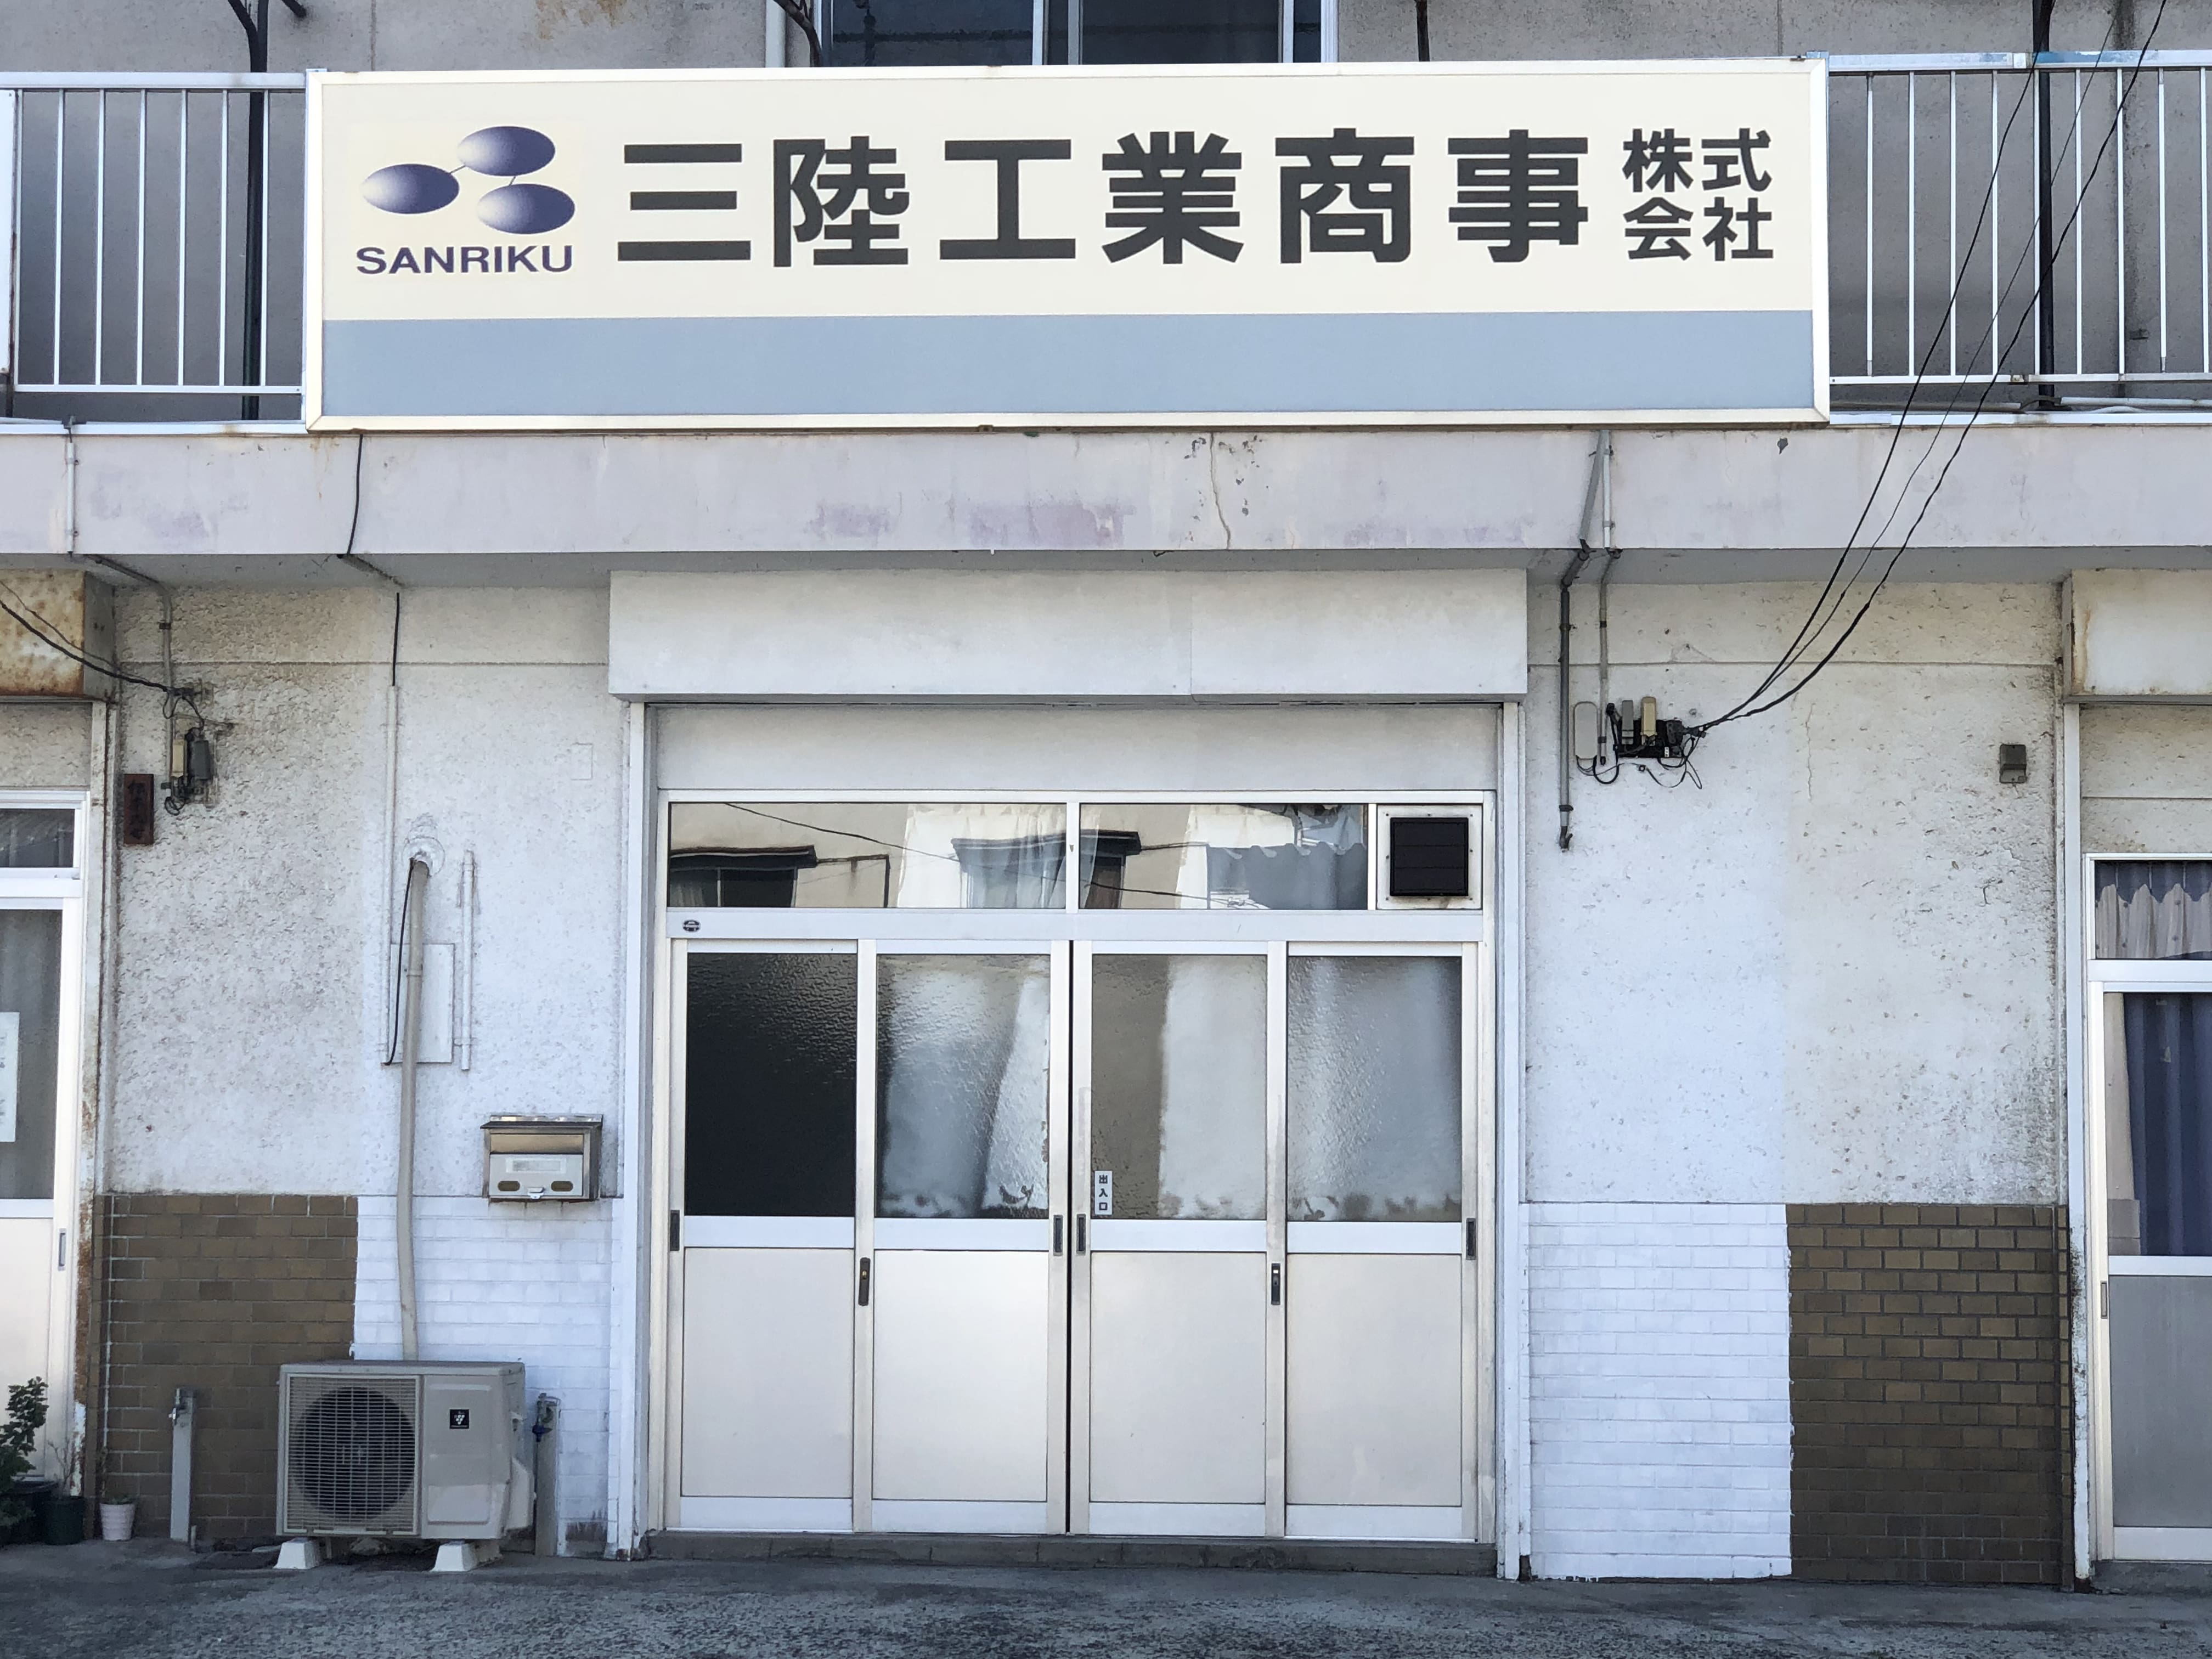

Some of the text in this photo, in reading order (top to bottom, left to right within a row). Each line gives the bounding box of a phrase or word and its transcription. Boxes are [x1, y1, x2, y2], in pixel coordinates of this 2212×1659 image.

[618, 128, 1588, 267] 三陸工業商事
[357, 246, 571, 274] SANRIKU
[1099, 1174, 1108, 1211] 出入口
